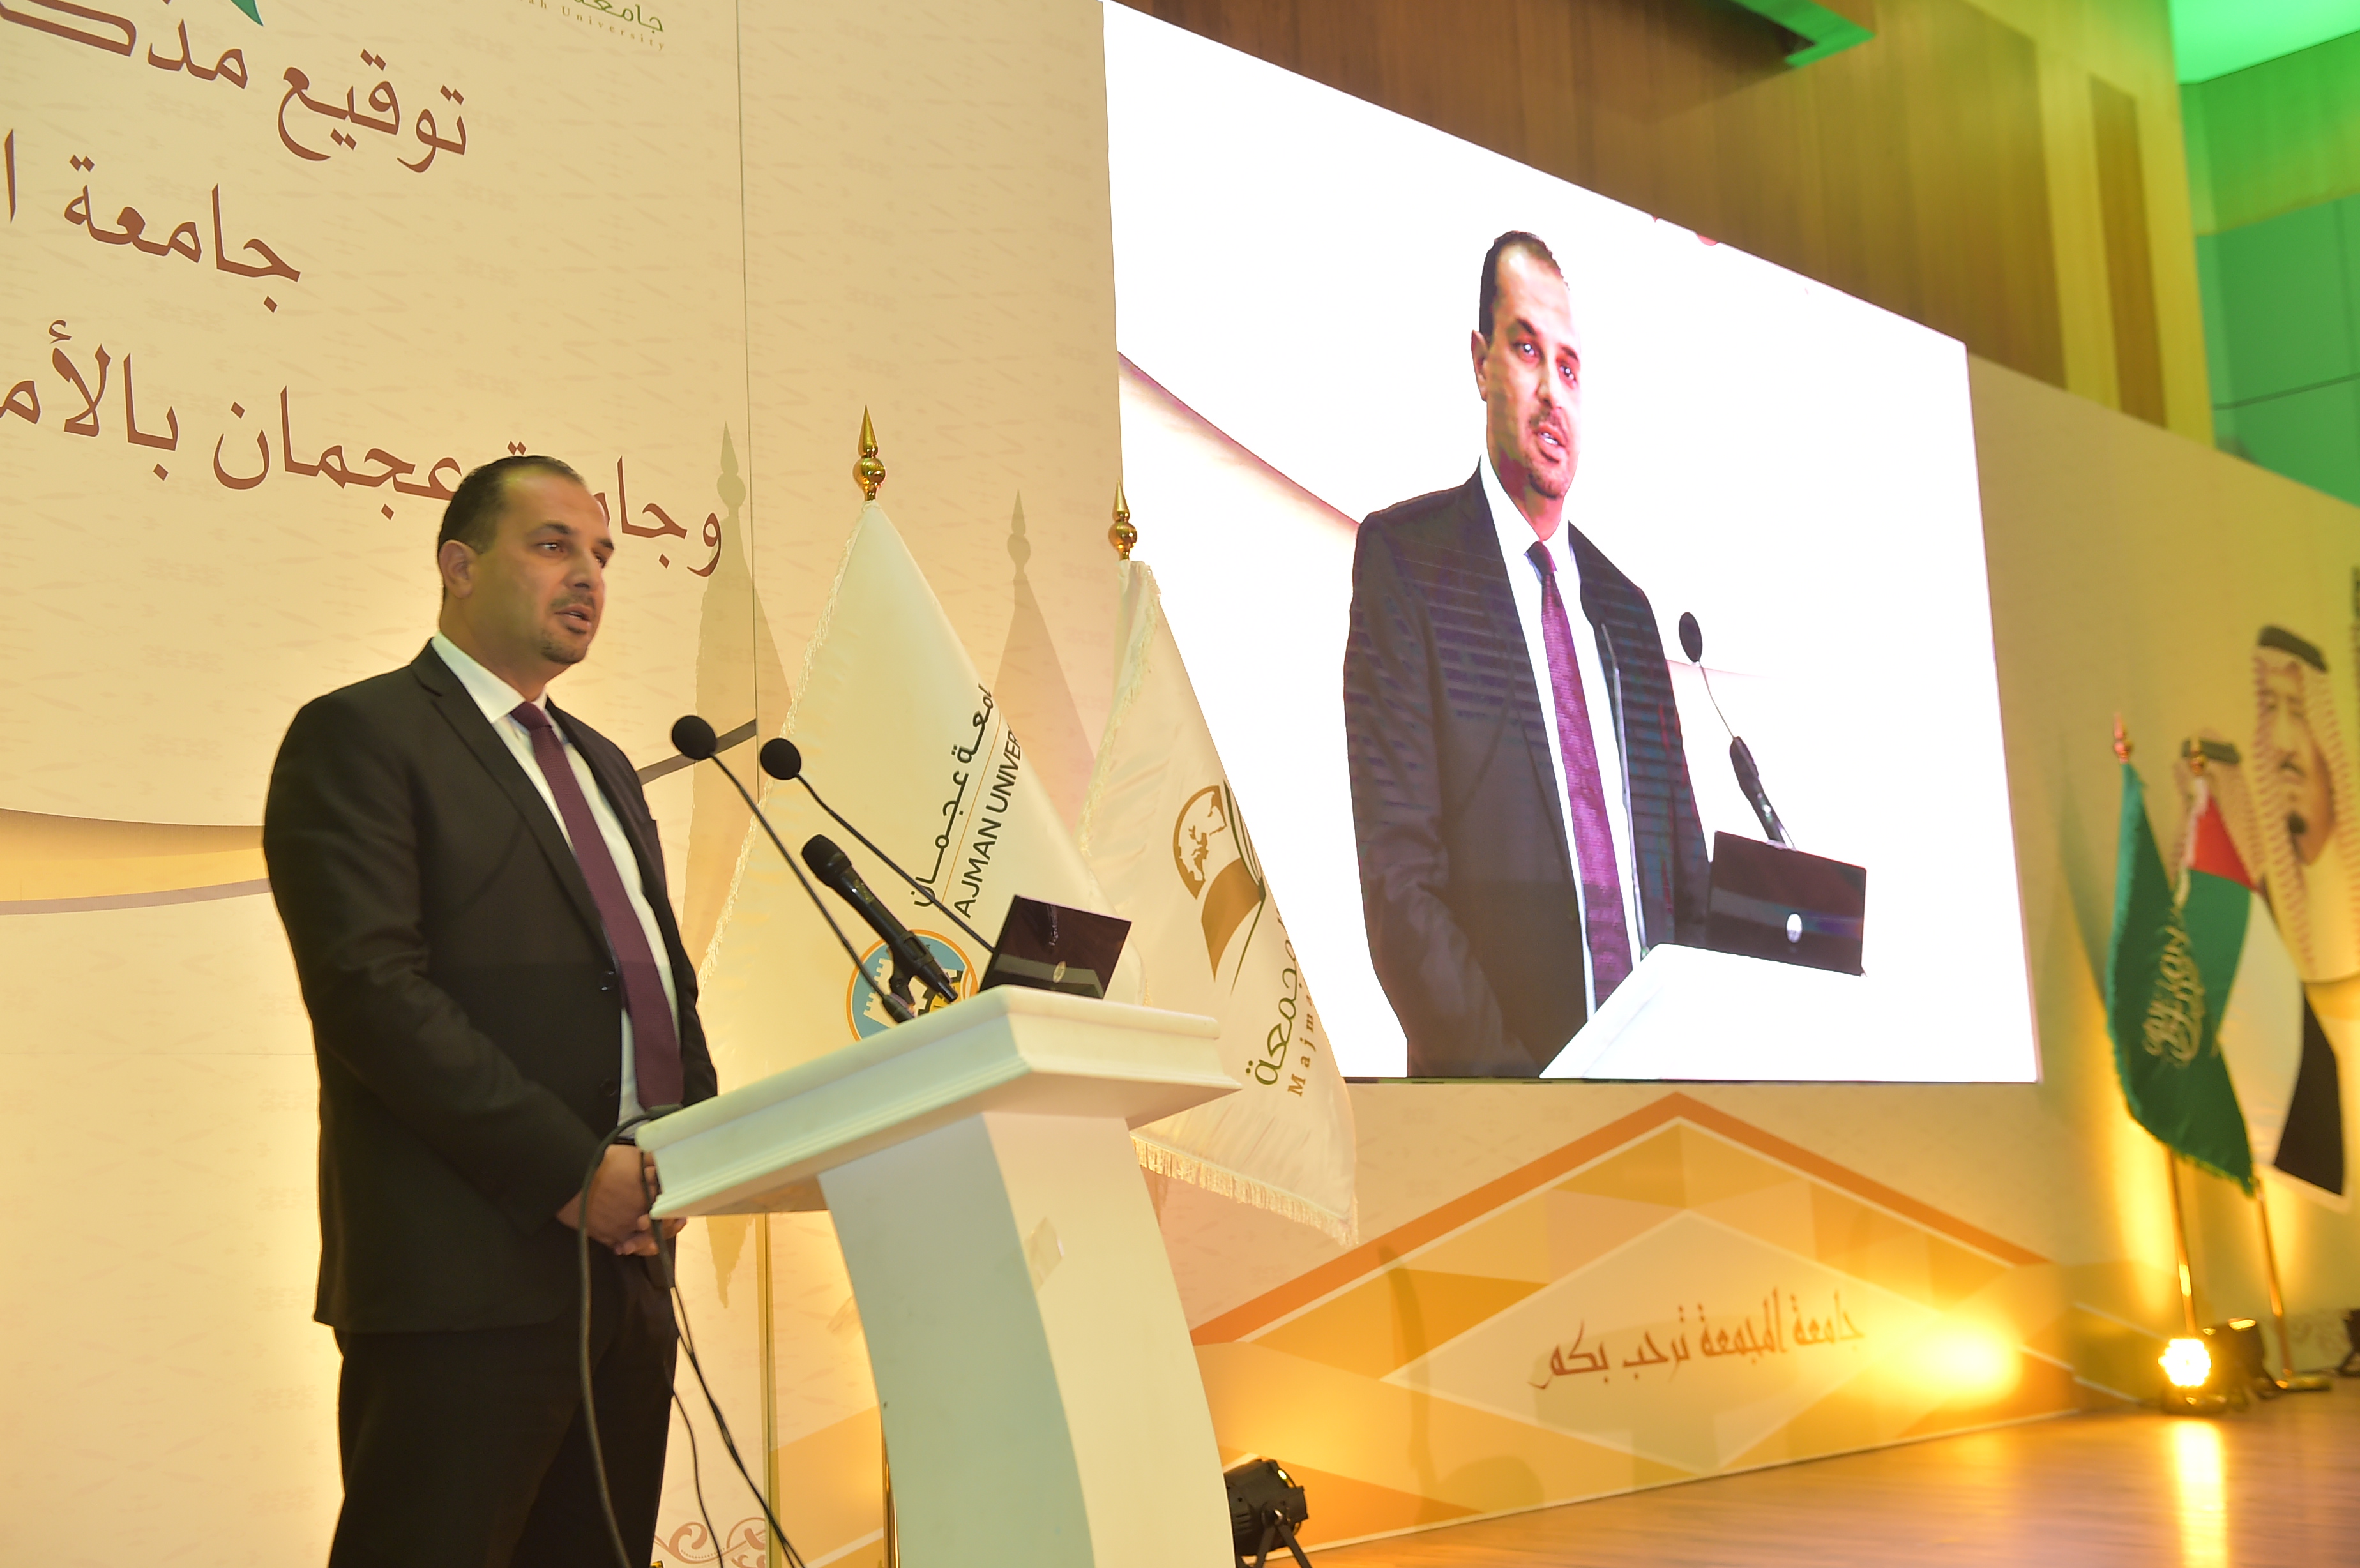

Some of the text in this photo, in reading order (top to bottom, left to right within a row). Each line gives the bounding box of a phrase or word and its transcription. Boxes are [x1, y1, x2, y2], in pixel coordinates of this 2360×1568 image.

[0, 0, 467, 172] توقيع مذك
[561, 6, 665, 50] University
[574, 0, 663, 33] جامع
[64, 155, 300, 312] جامعة
[0, 320, 723, 577] وجا عجمان بالأم
[911, 682, 994, 907] امعة عجمان
[954, 723, 1021, 919] AJMAN UNIVER
[1246, 907, 1302, 1085] مجمعة
[1527, 1286, 1865, 1389] جامعة المجمعة ترحب بكم
